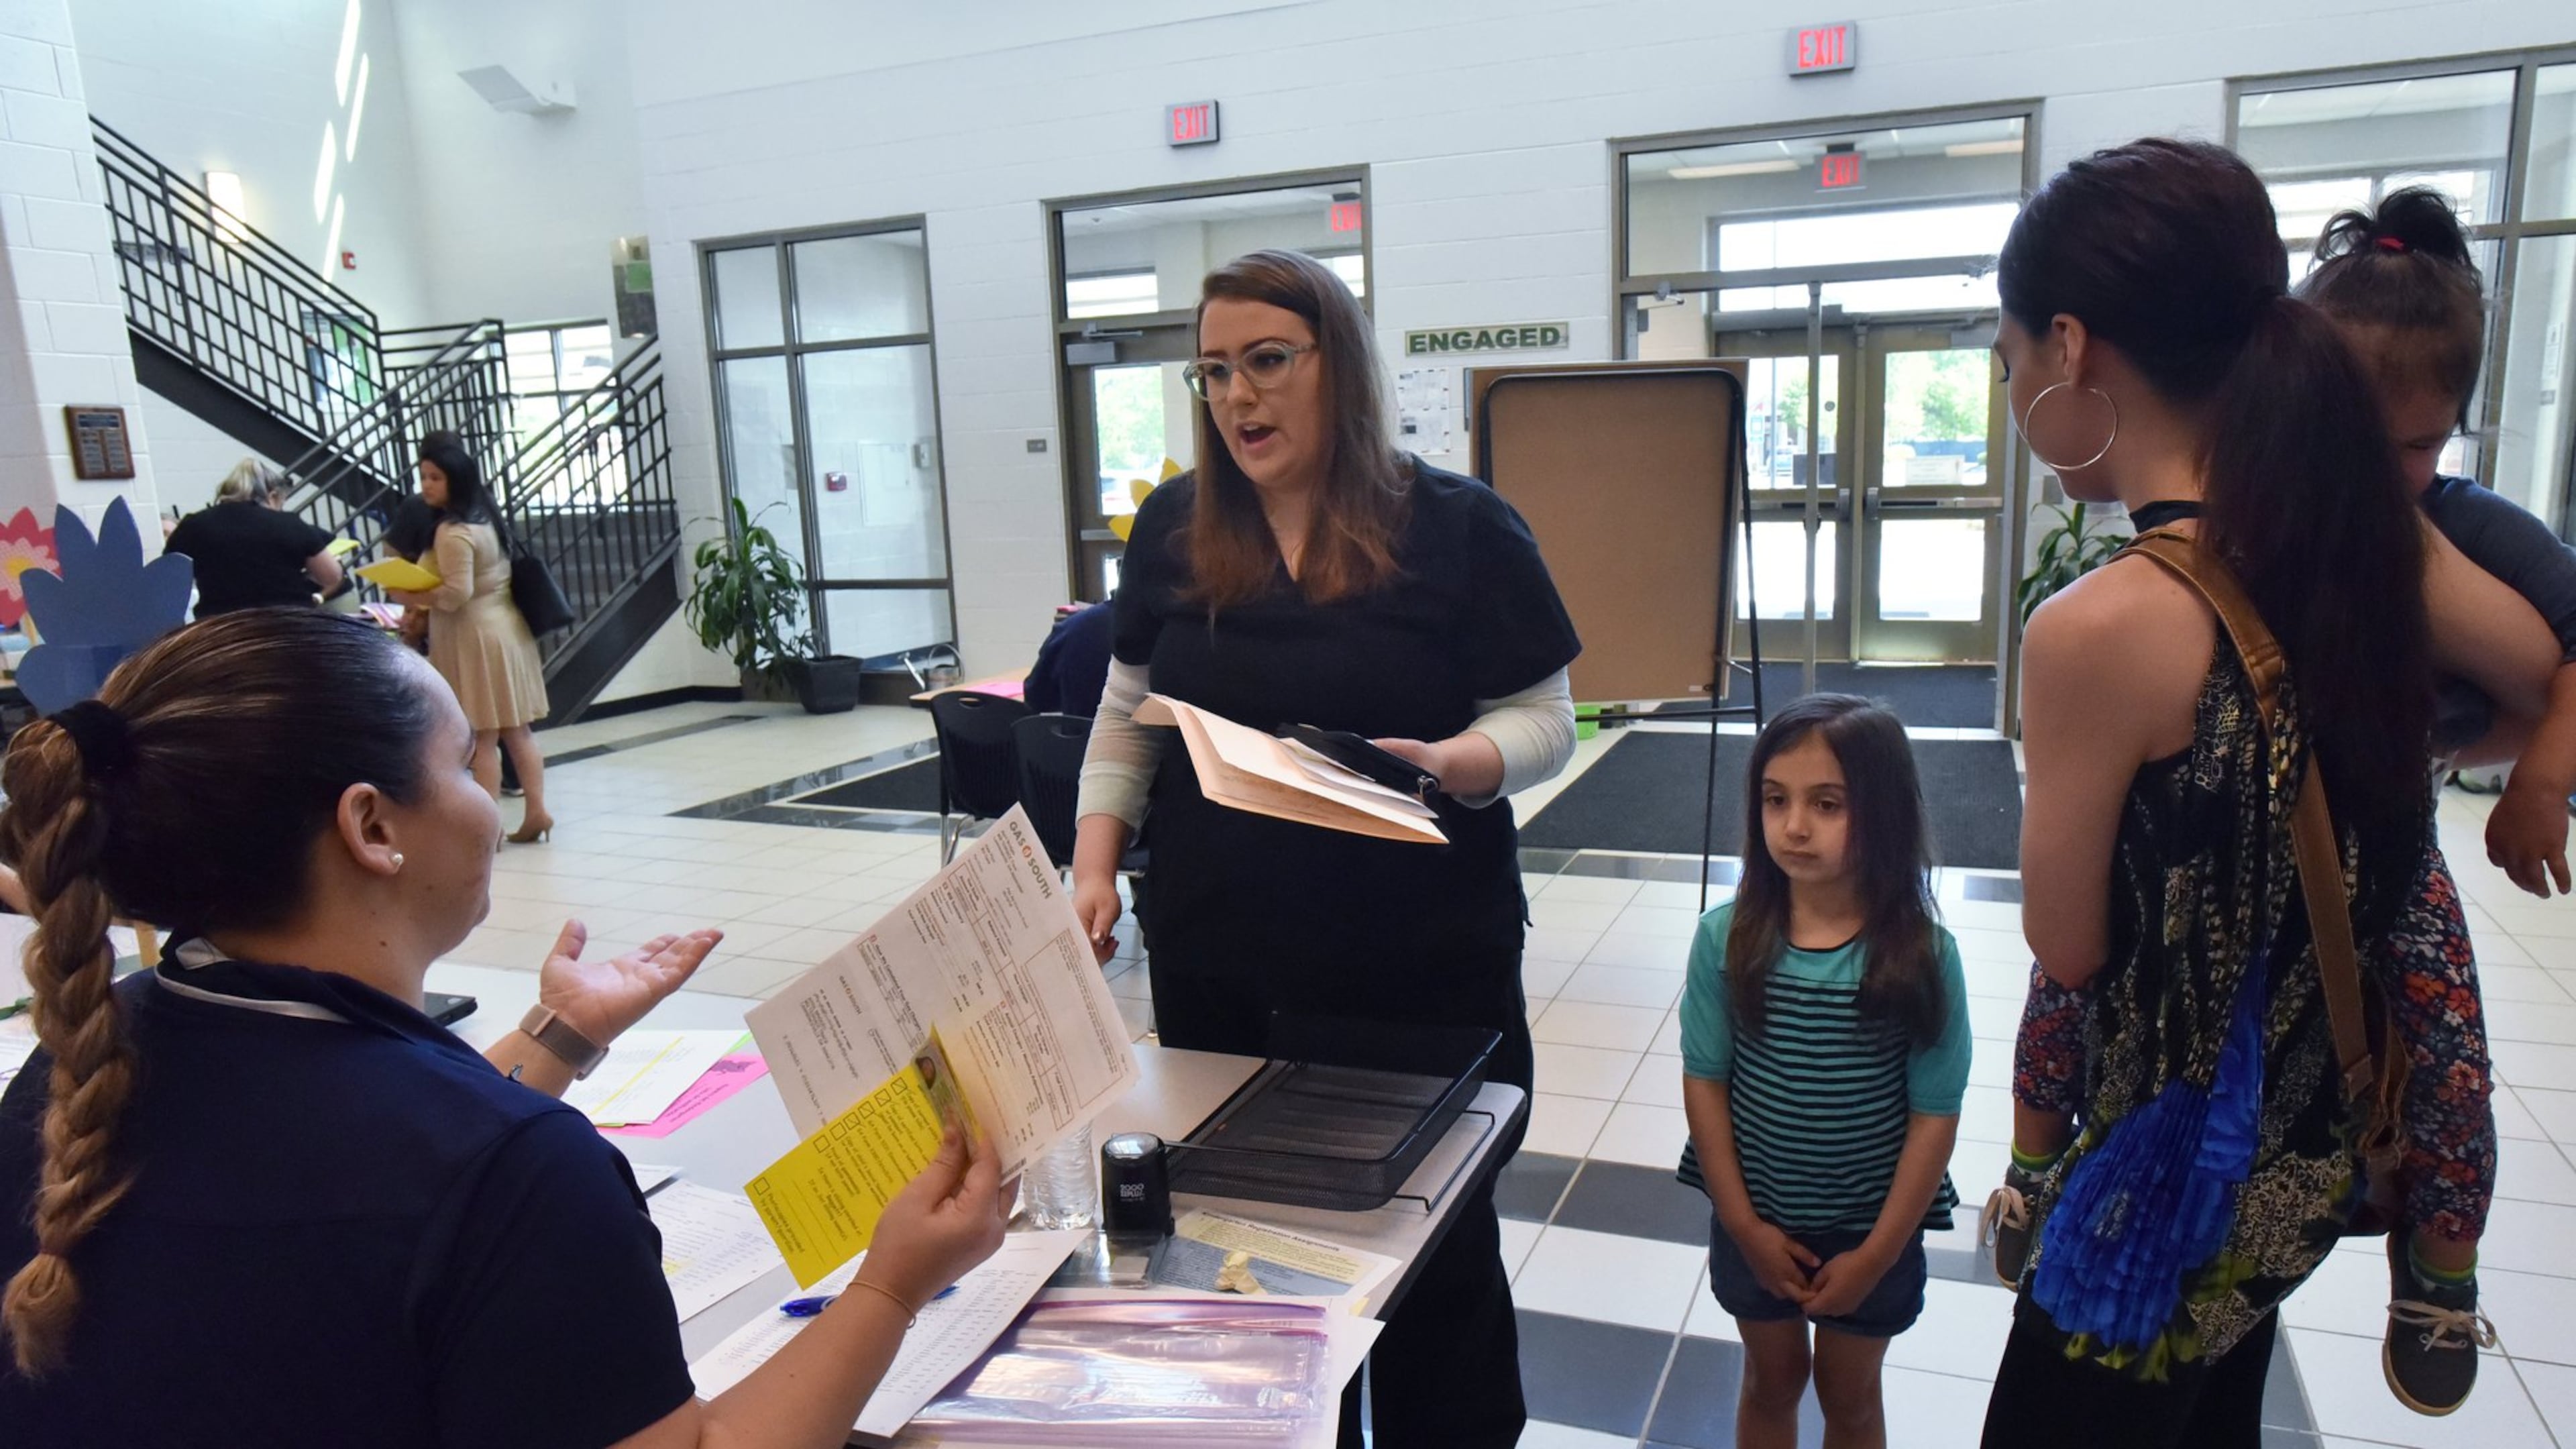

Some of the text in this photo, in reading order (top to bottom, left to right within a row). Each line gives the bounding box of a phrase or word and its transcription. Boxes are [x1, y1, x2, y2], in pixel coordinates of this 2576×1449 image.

[1798, 25, 1846, 68] EXIT
[1173, 105, 1209, 140] EXIT
[1821, 153, 1860, 187] EXIT
[1409, 327, 1560, 353] ENGAGED
[1008, 820, 1027, 846] GAS
[1027, 857, 1052, 900] SOUTH
[1248, 1222, 1291, 1240] Registration
[1292, 1234, 1340, 1252] Assignments
